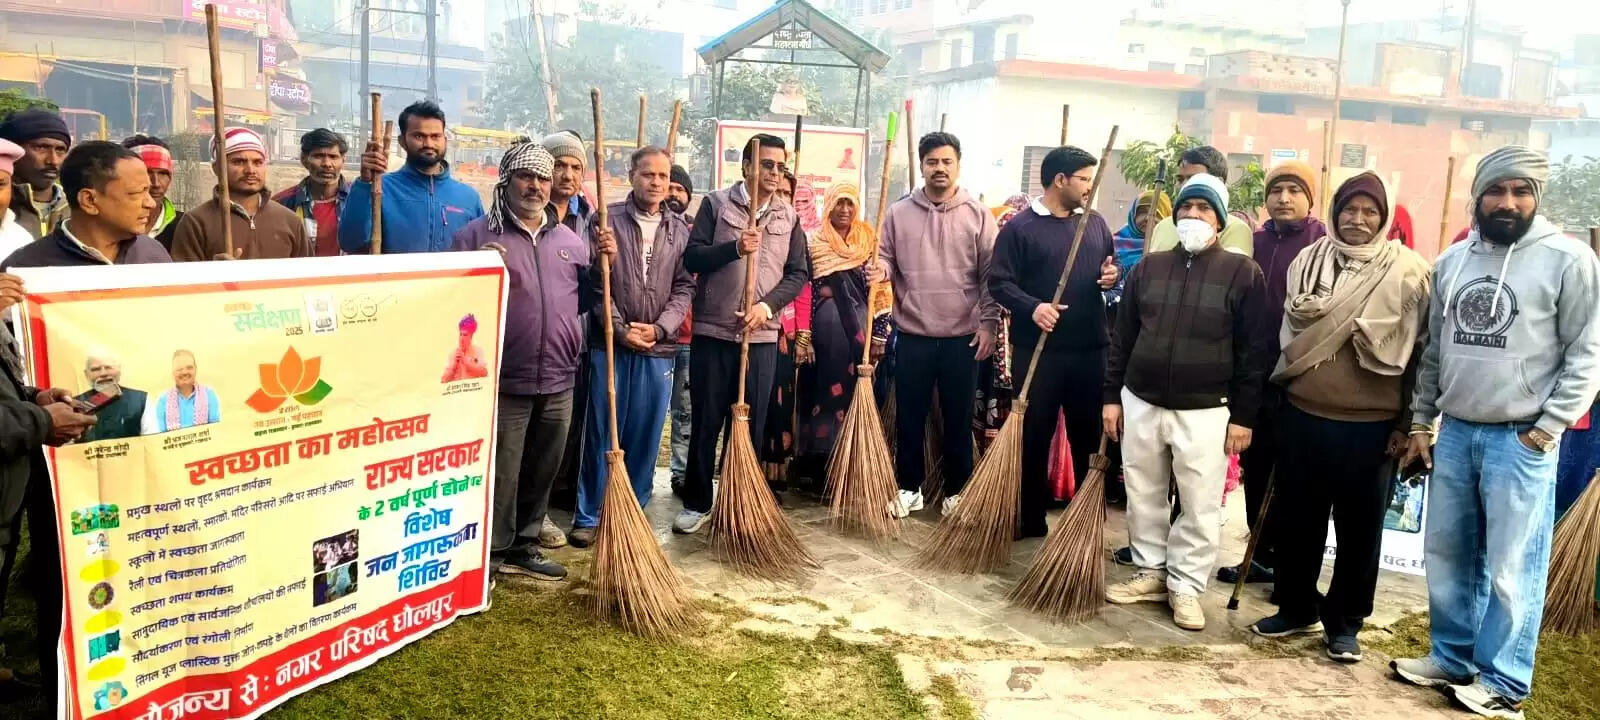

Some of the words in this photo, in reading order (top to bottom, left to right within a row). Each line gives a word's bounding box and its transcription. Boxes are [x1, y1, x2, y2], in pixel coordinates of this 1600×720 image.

[285, 327, 304, 337] 2025
[185, 442, 292, 485] स्वच्छता
[295, 432, 333, 459] का
[336, 413, 431, 450] महोत्सव
[364, 454, 415, 491] राज्य
[416, 438, 484, 476] सरकार
[126, 504, 152, 520] प्रमुख
[184, 497, 196, 507] पर
[214, 484, 240, 499] श्रमदान
[278, 491, 295, 506] आदि
[295, 490, 305, 502] पर
[328, 478, 355, 493] अभियान
[357, 505, 372, 521] के
[375, 500, 385, 516] 2
[388, 487, 412, 511] वर्ष
[412, 479, 438, 508] पूर्ण
[441, 475, 470, 497] होने
[471, 475, 483, 487] पर
[404, 507, 453, 538] विशेष
[169, 543, 208, 559] स्वच्छता
[364, 551, 399, 578] जन
[165, 566, 208, 583] चित्रकला
[398, 559, 452, 593] शिविर
[130, 597, 166, 616] स्वच्छता
[168, 591, 193, 604] शपथ
[131, 617, 179, 640] सामुदायिक
[275, 585, 286, 598] की
[275, 646, 327, 686] नगर
[329, 618, 389, 662] परिषद
[393, 592, 454, 634] धौलपुर
[179, 655, 220, 669] प्लास्टिक
